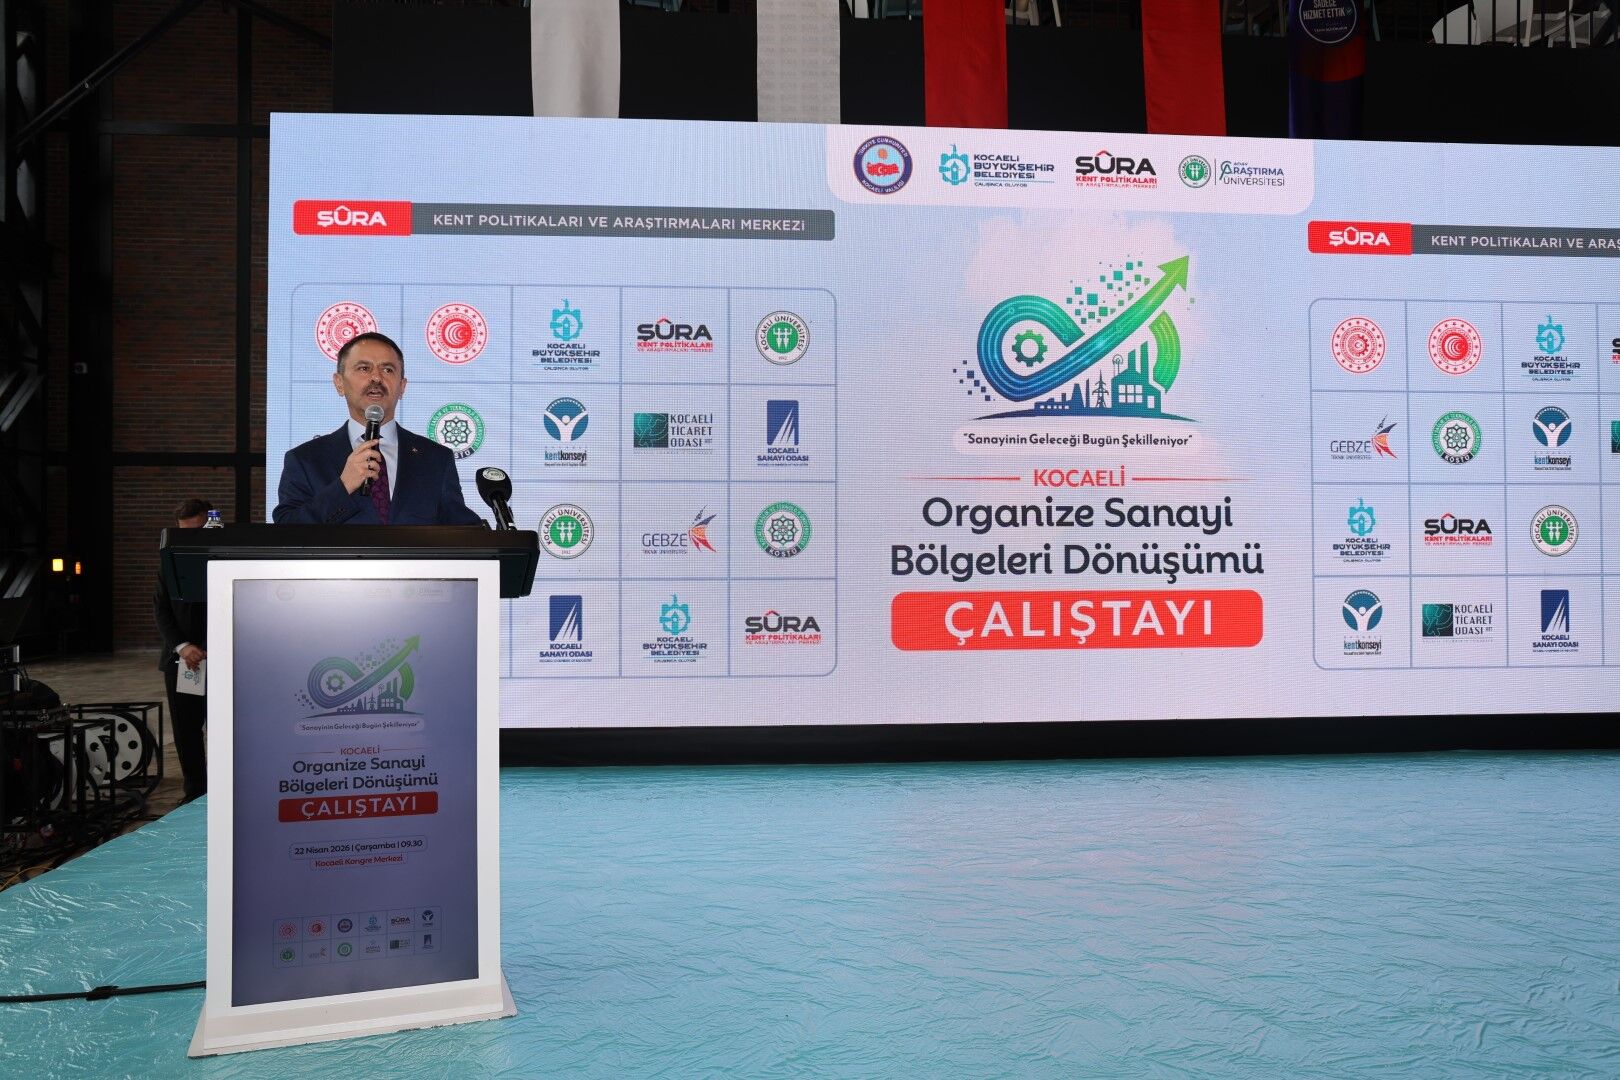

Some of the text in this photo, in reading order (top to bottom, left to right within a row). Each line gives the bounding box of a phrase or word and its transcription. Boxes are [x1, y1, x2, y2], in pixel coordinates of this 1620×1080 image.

[974, 162, 1055, 172] BÜYÜKŞEHİR
[974, 171, 1035, 179] BELEDİYESİ
[1100, 175, 1157, 184] POLİTİKALARI
[1224, 176, 1285, 187] ÜNİVERSİTESİ
[434, 214, 805, 231] KENT POLİTİKALARI VE ARAŞTIRMALARI MERKEZİ
[1432, 235, 1466, 247] KENT
[1471, 236, 1562, 248] POLİTİKALARI
[1567, 238, 1584, 249] VE
[670, 413, 713, 423] KOCAELİ
[671, 426, 712, 436] TİCARET
[670, 438, 702, 447] ODASI
[1029, 433, 1080, 447] Geleceği
[1083, 434, 1119, 447] Bugün
[1331, 440, 1371, 452] GEBZE
[1034, 465, 1125, 487] KOCAELİ
[922, 496, 1232, 535] Organize Sanayi
[642, 533, 688, 546] GEBZE
[891, 542, 1264, 584] Bölgeleri Dönüşümü
[1455, 603, 1493, 613] KOCAELİ
[945, 600, 1212, 646] ÇALIŞTAYI
[1455, 616, 1492, 625] TİCARET
[1455, 626, 1483, 635] ODASI
[341, 745, 380, 755] KOCAELİ
[293, 755, 425, 775] Organize Sanayi
[279, 772, 438, 794] Bölgeleri Dönüşümü
[302, 796, 416, 819] ÇALIŞTAYI
[294, 847, 304, 855] 22
[355, 842, 395, 851] Çarşamba
[315, 859, 343, 867] Kocaeli
